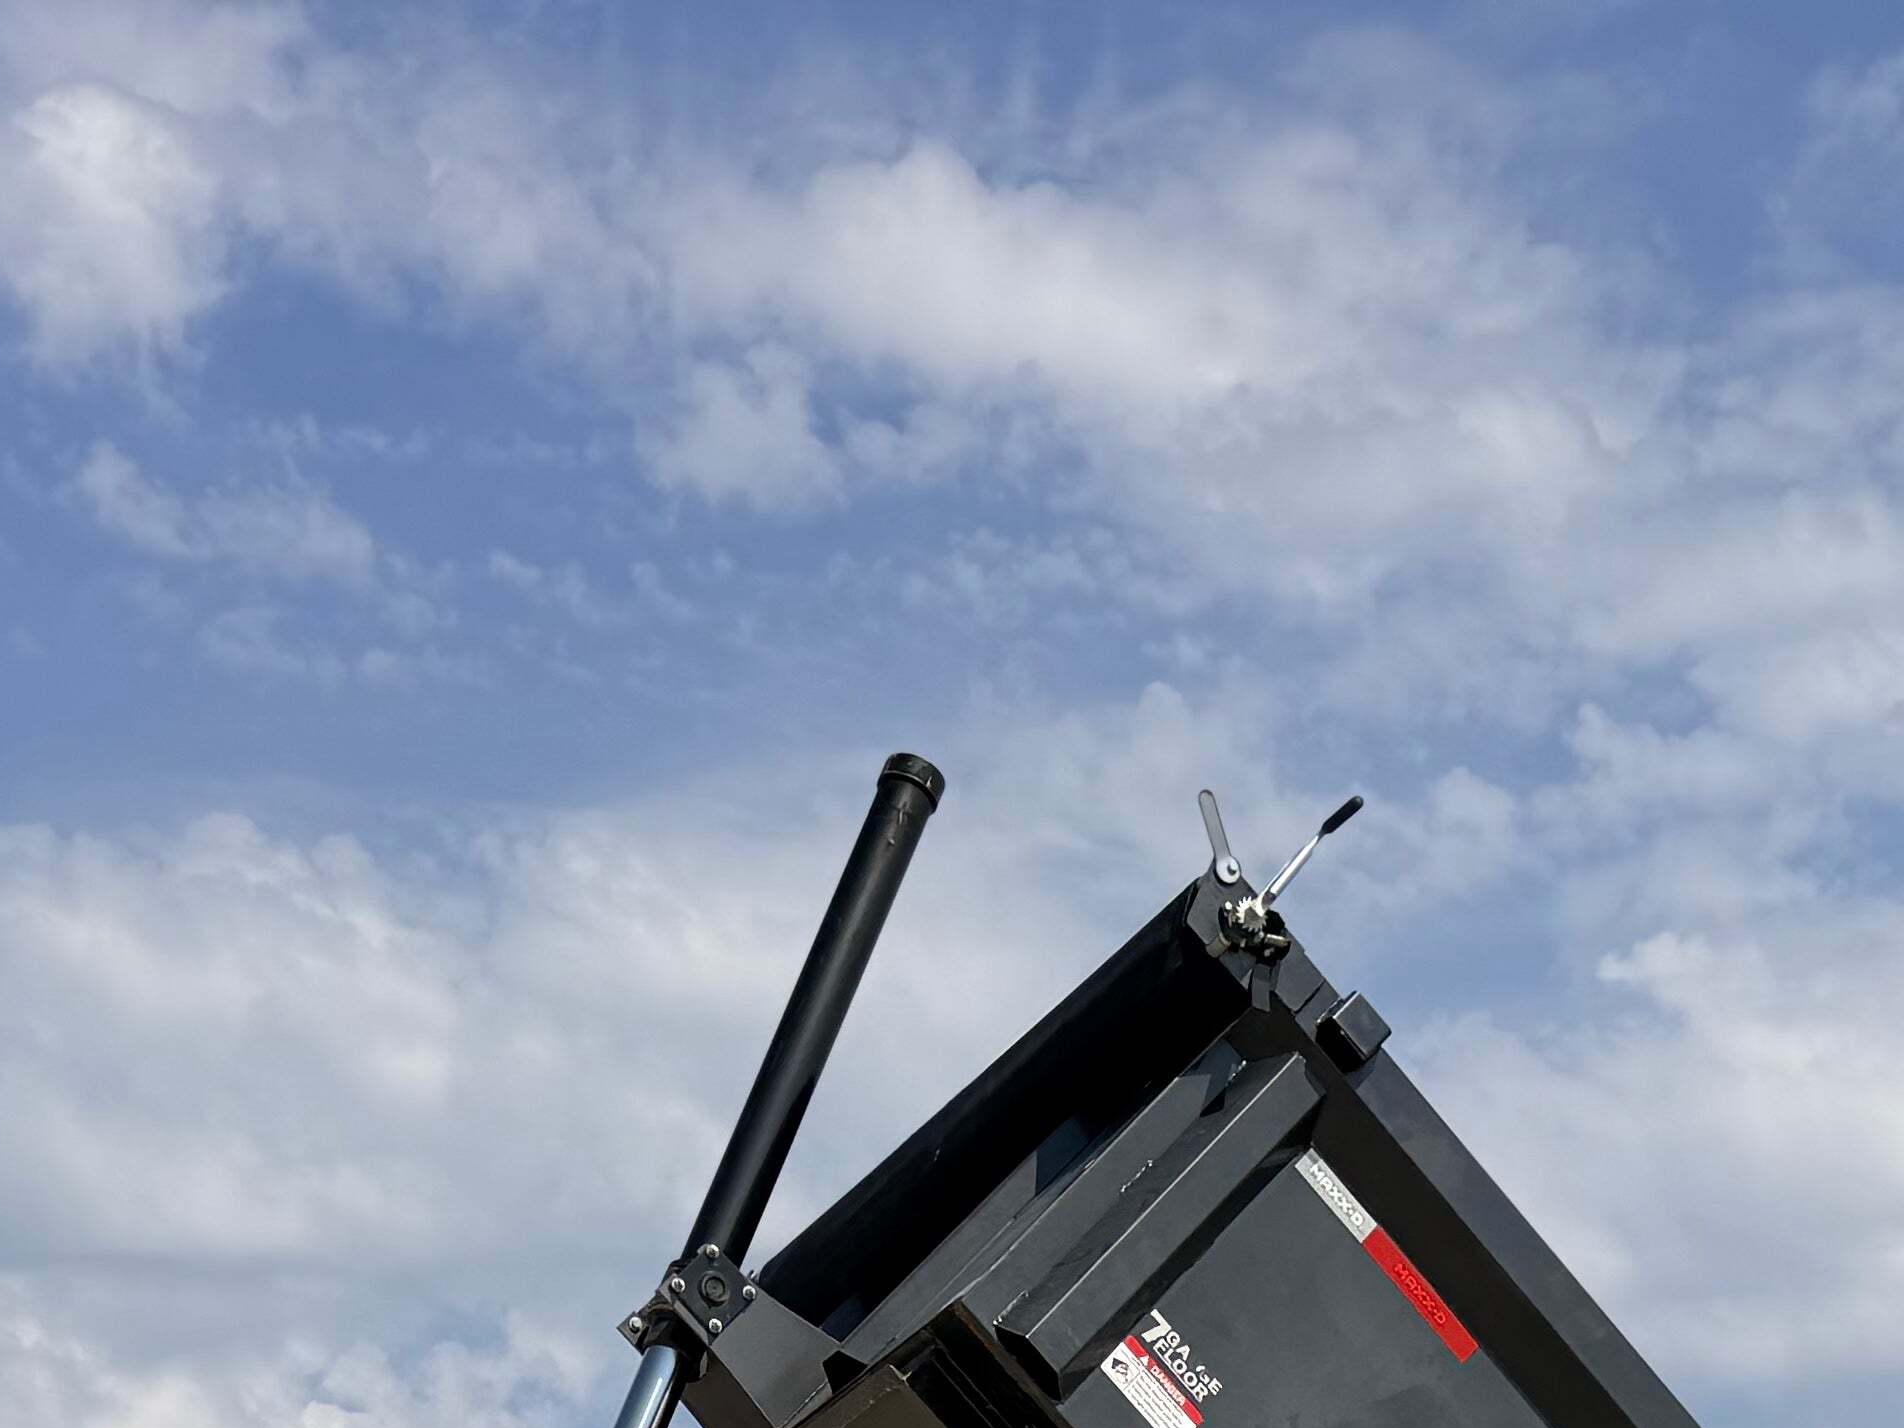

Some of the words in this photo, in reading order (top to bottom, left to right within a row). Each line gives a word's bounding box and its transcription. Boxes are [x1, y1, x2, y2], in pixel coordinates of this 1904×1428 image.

[1310, 1163, 1364, 1227] MAXX-D
[1394, 1263, 1446, 1325] MAXX-D
[1141, 1309, 1172, 1342] 7
[1166, 1331, 1223, 1396] GAGE
[1153, 1338, 1208, 1402] FLOOR
